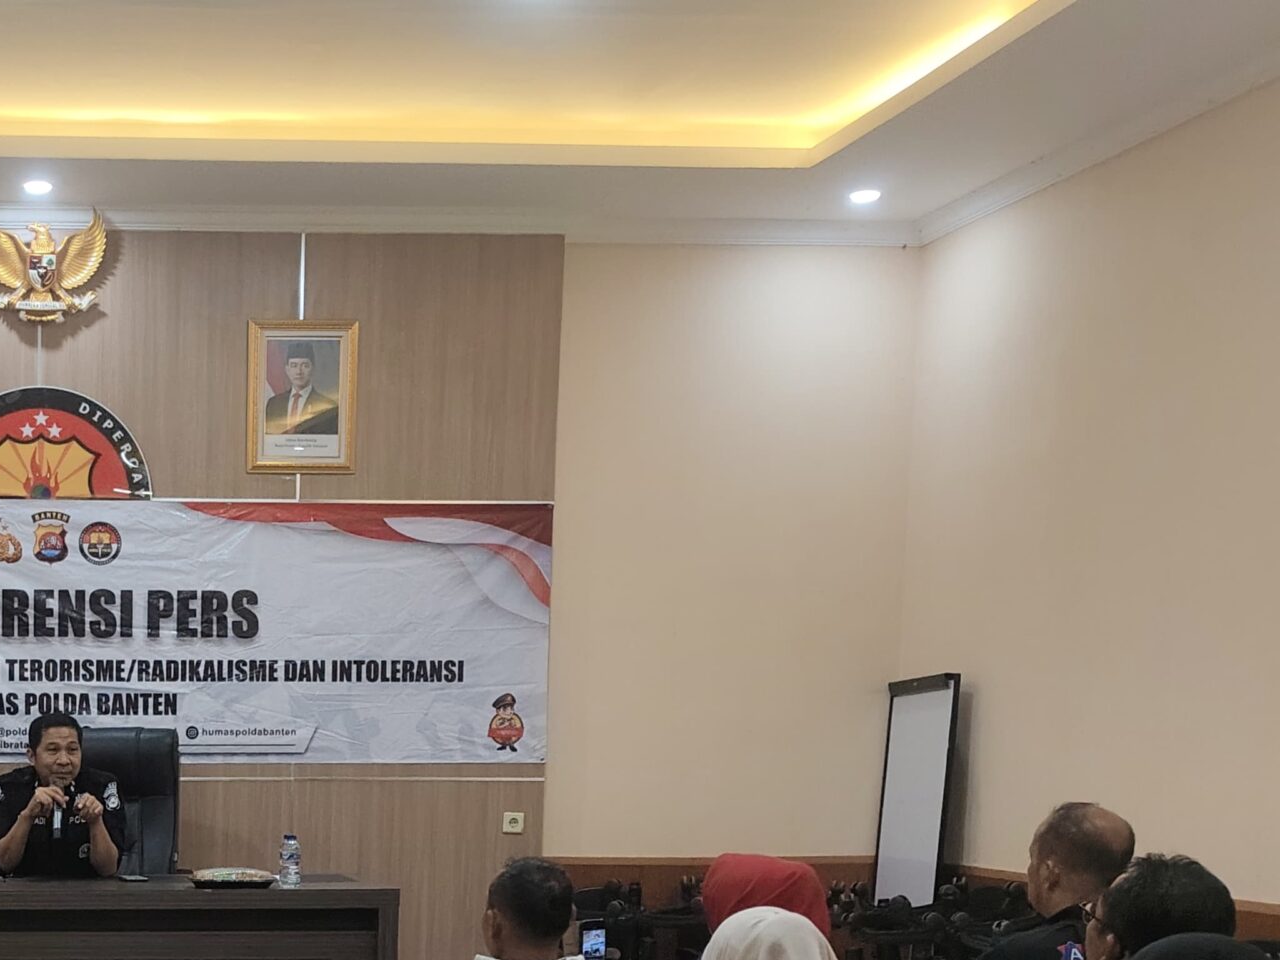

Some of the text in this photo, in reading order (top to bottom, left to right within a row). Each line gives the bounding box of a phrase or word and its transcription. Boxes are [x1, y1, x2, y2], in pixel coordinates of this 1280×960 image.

[78, 402, 146, 498] DIPERCAY
[34, 511, 68, 522] BANTEN
[147, 589, 260, 639] PERS
[6, 658, 279, 683] TERORISME/RADIKALISME
[284, 659, 326, 683] DAN
[331, 660, 465, 683] INTOLERANSI
[24, 693, 92, 716] POLDA
[97, 693, 178, 716] BANTEN
[201, 727, 297, 738] humaspoldabanten
